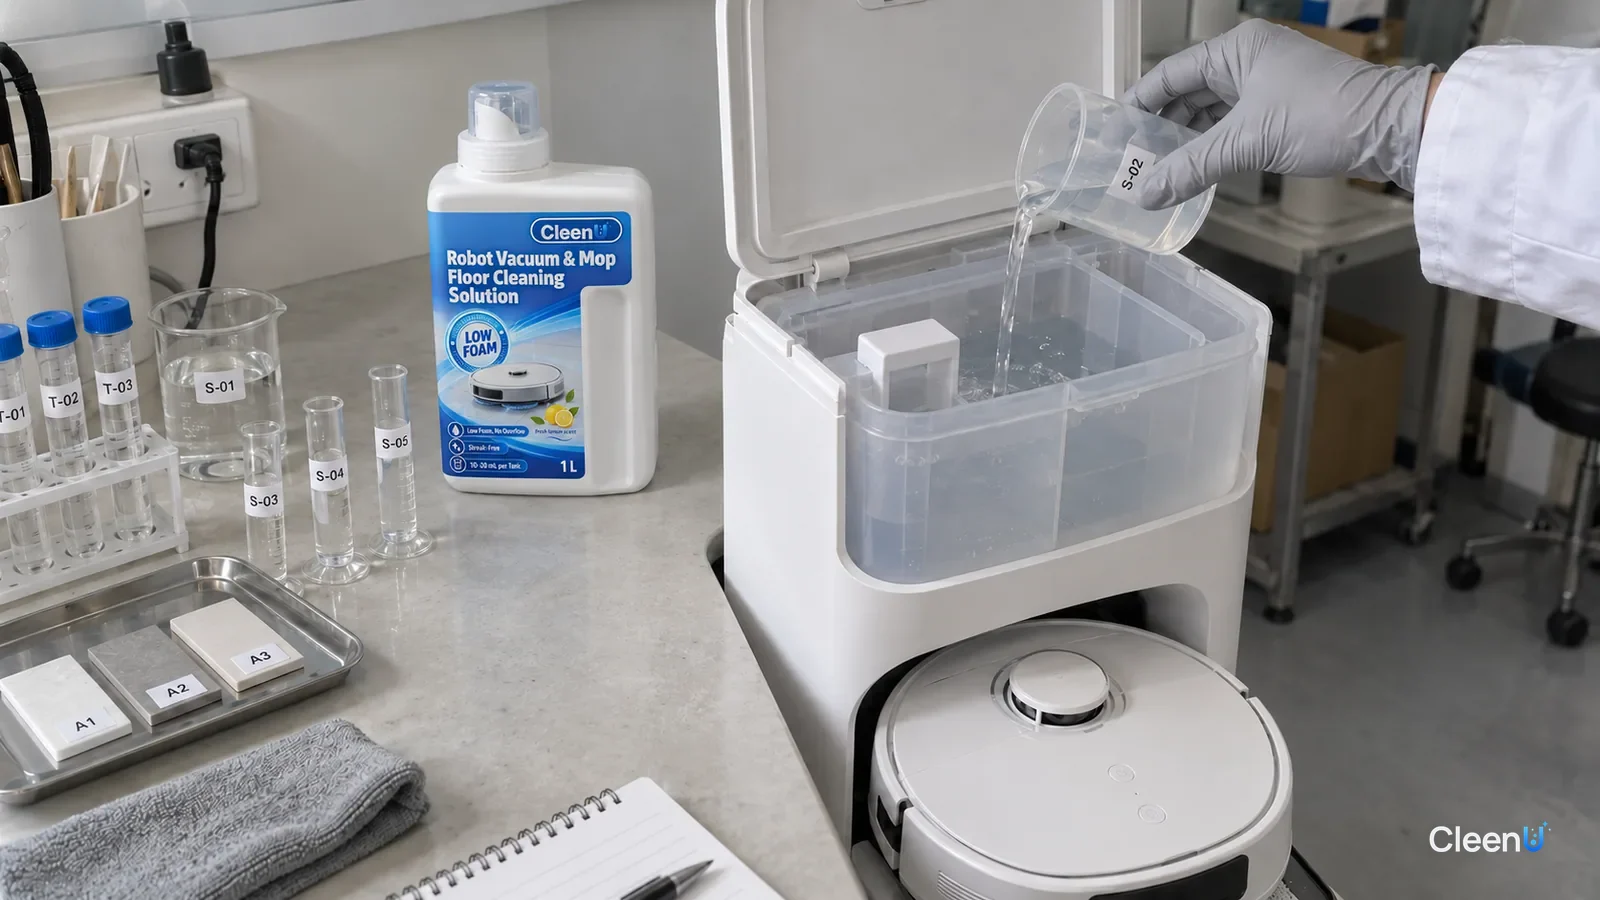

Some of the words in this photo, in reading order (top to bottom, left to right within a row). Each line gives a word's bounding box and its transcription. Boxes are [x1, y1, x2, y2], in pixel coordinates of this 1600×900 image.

[1121, 158, 1144, 191] S-02
[540, 223, 607, 240] CleenU
[446, 249, 493, 266] Robot
[495, 250, 560, 267] Vacuum
[563, 250, 576, 267] &
[579, 250, 617, 270] Mop
[448, 269, 490, 285] Floor
[493, 269, 565, 289] Cleaning
[449, 286, 519, 304] Solution
[464, 328, 492, 344] LOW
[463, 341, 497, 358] FOAM
[103, 378, 133, 395] T-03
[205, 380, 235, 394] S-01
[48, 391, 79, 408] T-02
[381, 434, 409, 449] S-05
[315, 467, 345, 482] S-04
[498, 463, 507, 471] per
[249, 494, 279, 507] S-03
[250, 651, 272, 665] A3
[166, 683, 190, 698] A2
[75, 717, 97, 732] A1
